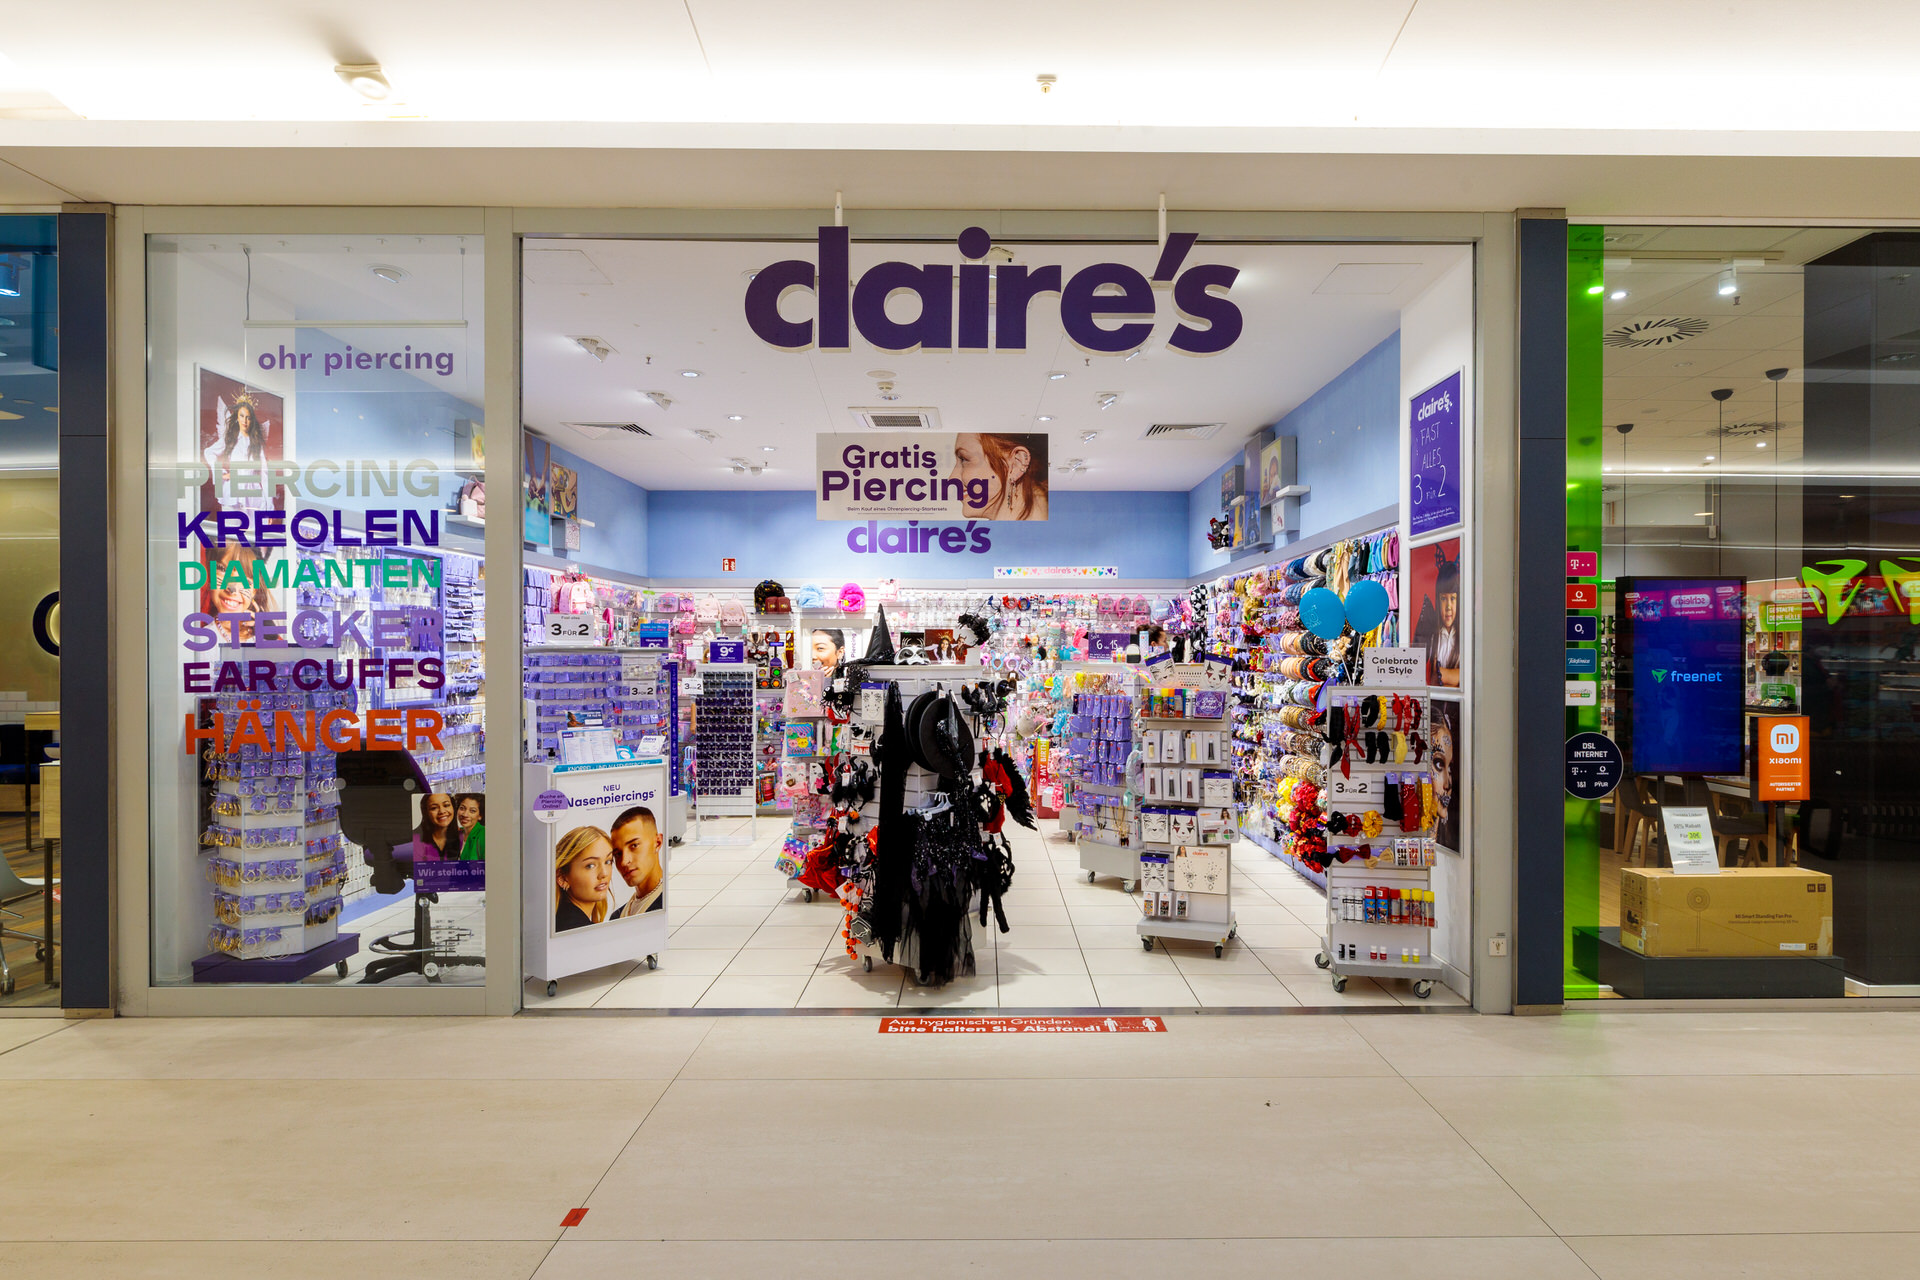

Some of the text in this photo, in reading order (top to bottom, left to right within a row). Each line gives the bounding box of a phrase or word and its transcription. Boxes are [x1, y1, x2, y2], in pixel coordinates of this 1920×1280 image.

[744, 226, 1244, 354] claire's
[258, 345, 454, 376] ohr piercing
[1418, 391, 1450, 421] claire's
[1420, 422, 1440, 446] FAST
[843, 444, 937, 469] Gratis
[1422, 448, 1441, 471] ALLES
[177, 459, 439, 500] PIERCING
[822, 469, 989, 509] Piercing
[1414, 474, 1423, 505] 3
[1438, 465, 1446, 497] 2
[178, 509, 439, 549] KREOLEN
[847, 520, 992, 554] claire's
[178, 558, 441, 590] DIAMANTEN
[182, 609, 444, 652] STECKER
[551, 624, 562, 636] 3
[578, 624, 589, 636] 2
[1372, 656, 1419, 665] Celebrate
[1377, 666, 1413, 675] in Style
[183, 658, 445, 694] EAR CUFFS
[1671, 670, 1723, 682] freenet
[185, 699, 445, 756] HÄNGER
[1574, 750, 1608, 758] INTERNET
[1582, 742, 1596, 750] DSL
[603, 784, 621, 792] NEU
[1335, 782, 1345, 793] 3
[1358, 782, 1368, 793] 2
[418, 867, 436, 876] Wir
[437, 867, 468, 877] stellen
[919, 1018, 1006, 1027] hygienischen
[1011, 1017, 1071, 1025] Gründen
